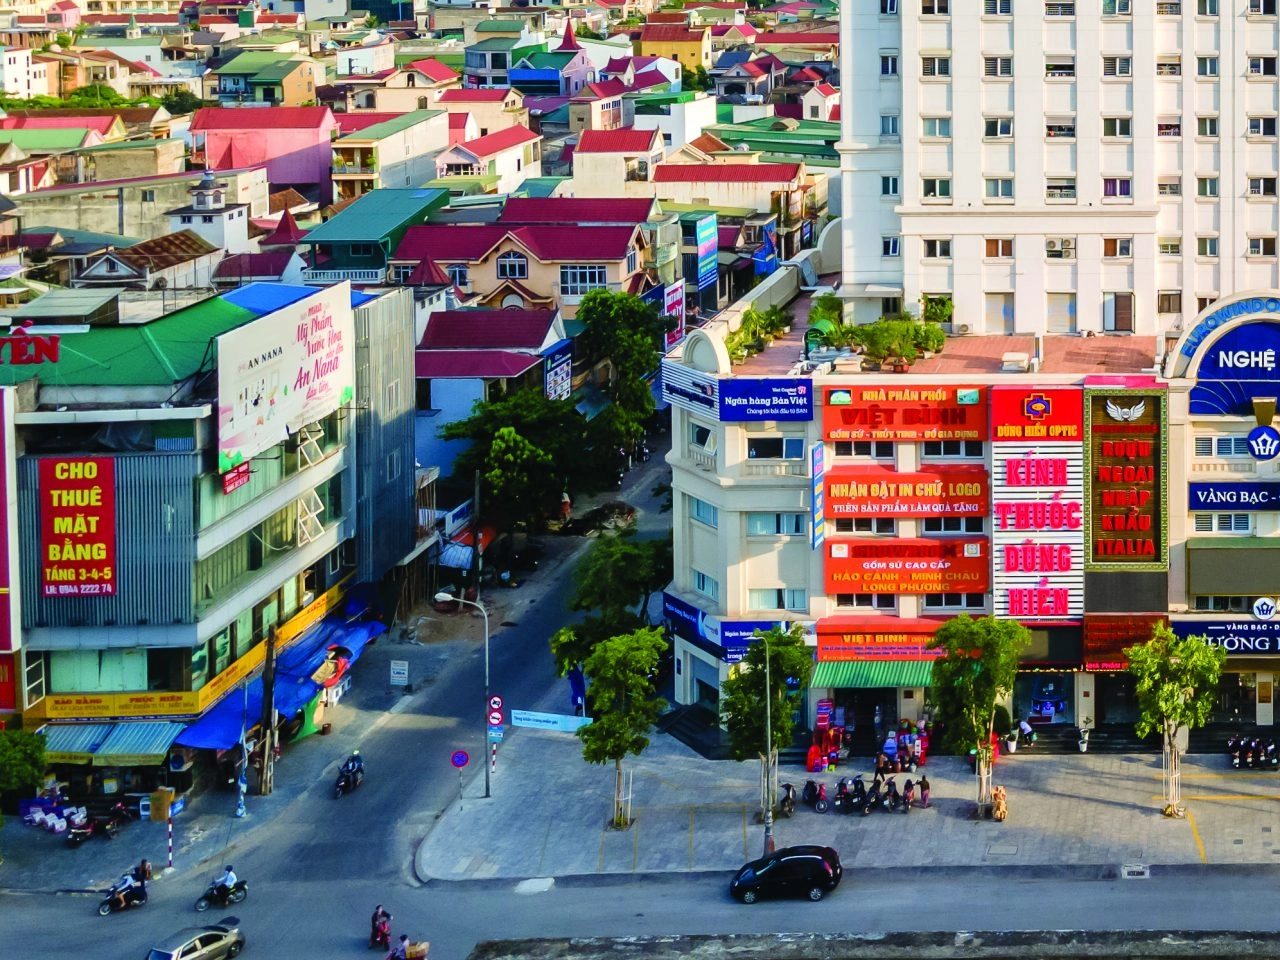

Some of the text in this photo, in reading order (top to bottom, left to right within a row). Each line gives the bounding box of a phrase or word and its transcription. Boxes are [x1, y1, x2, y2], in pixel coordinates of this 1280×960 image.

[248, 346, 283, 370] AN NANA
[1219, 348, 1276, 371] NGHỆ
[294, 356, 339, 392] An Nana
[725, 397, 748, 406] Ngân
[749, 396, 771, 406] hàng
[790, 396, 807, 406] Việt
[862, 387, 947, 401] NHÀ PHÂN PHỐI
[840, 403, 967, 429] VIỆT BÌNH
[1049, 424, 1078, 437] OPTIC
[1101, 438, 1150, 462] RƯỢU
[55, 462, 98, 480] CHO
[1005, 450, 1068, 486] KÍNH
[1098, 465, 1154, 487] NGOẠI
[50, 485, 103, 507] THUÊ
[830, 481, 868, 499] NHẬN
[870, 481, 897, 500] ĐẶT
[899, 483, 913, 497] IN
[949, 483, 981, 497] LOGO
[1197, 488, 1237, 503] VÀNG
[1240, 491, 1269, 505] BẠC
[833, 502, 858, 513] TRÊN
[861, 501, 879, 513] SẢN
[911, 501, 931, 513] LÀM
[931, 501, 951, 513] QUÀ
[953, 501, 979, 514] TẶNG
[993, 490, 1081, 530] THUỐC
[54, 513, 100, 538] MẶT
[1101, 506, 1151, 531] KHẨU
[48, 538, 107, 561] BẰNG
[1003, 538, 1072, 573] DŨNG
[1097, 538, 1156, 556] ITALIA
[79, 567, 112, 581] 3-4-5
[862, 560, 886, 569] GỐM
[888, 561, 903, 569] SỨ
[911, 572, 942, 581] MINH
[862, 583, 897, 592] LONG
[1226, 622, 1249, 631] VÀNG
[1250, 624, 1268, 632] BẠC
[1205, 633, 1271, 651] ƯỜNG
